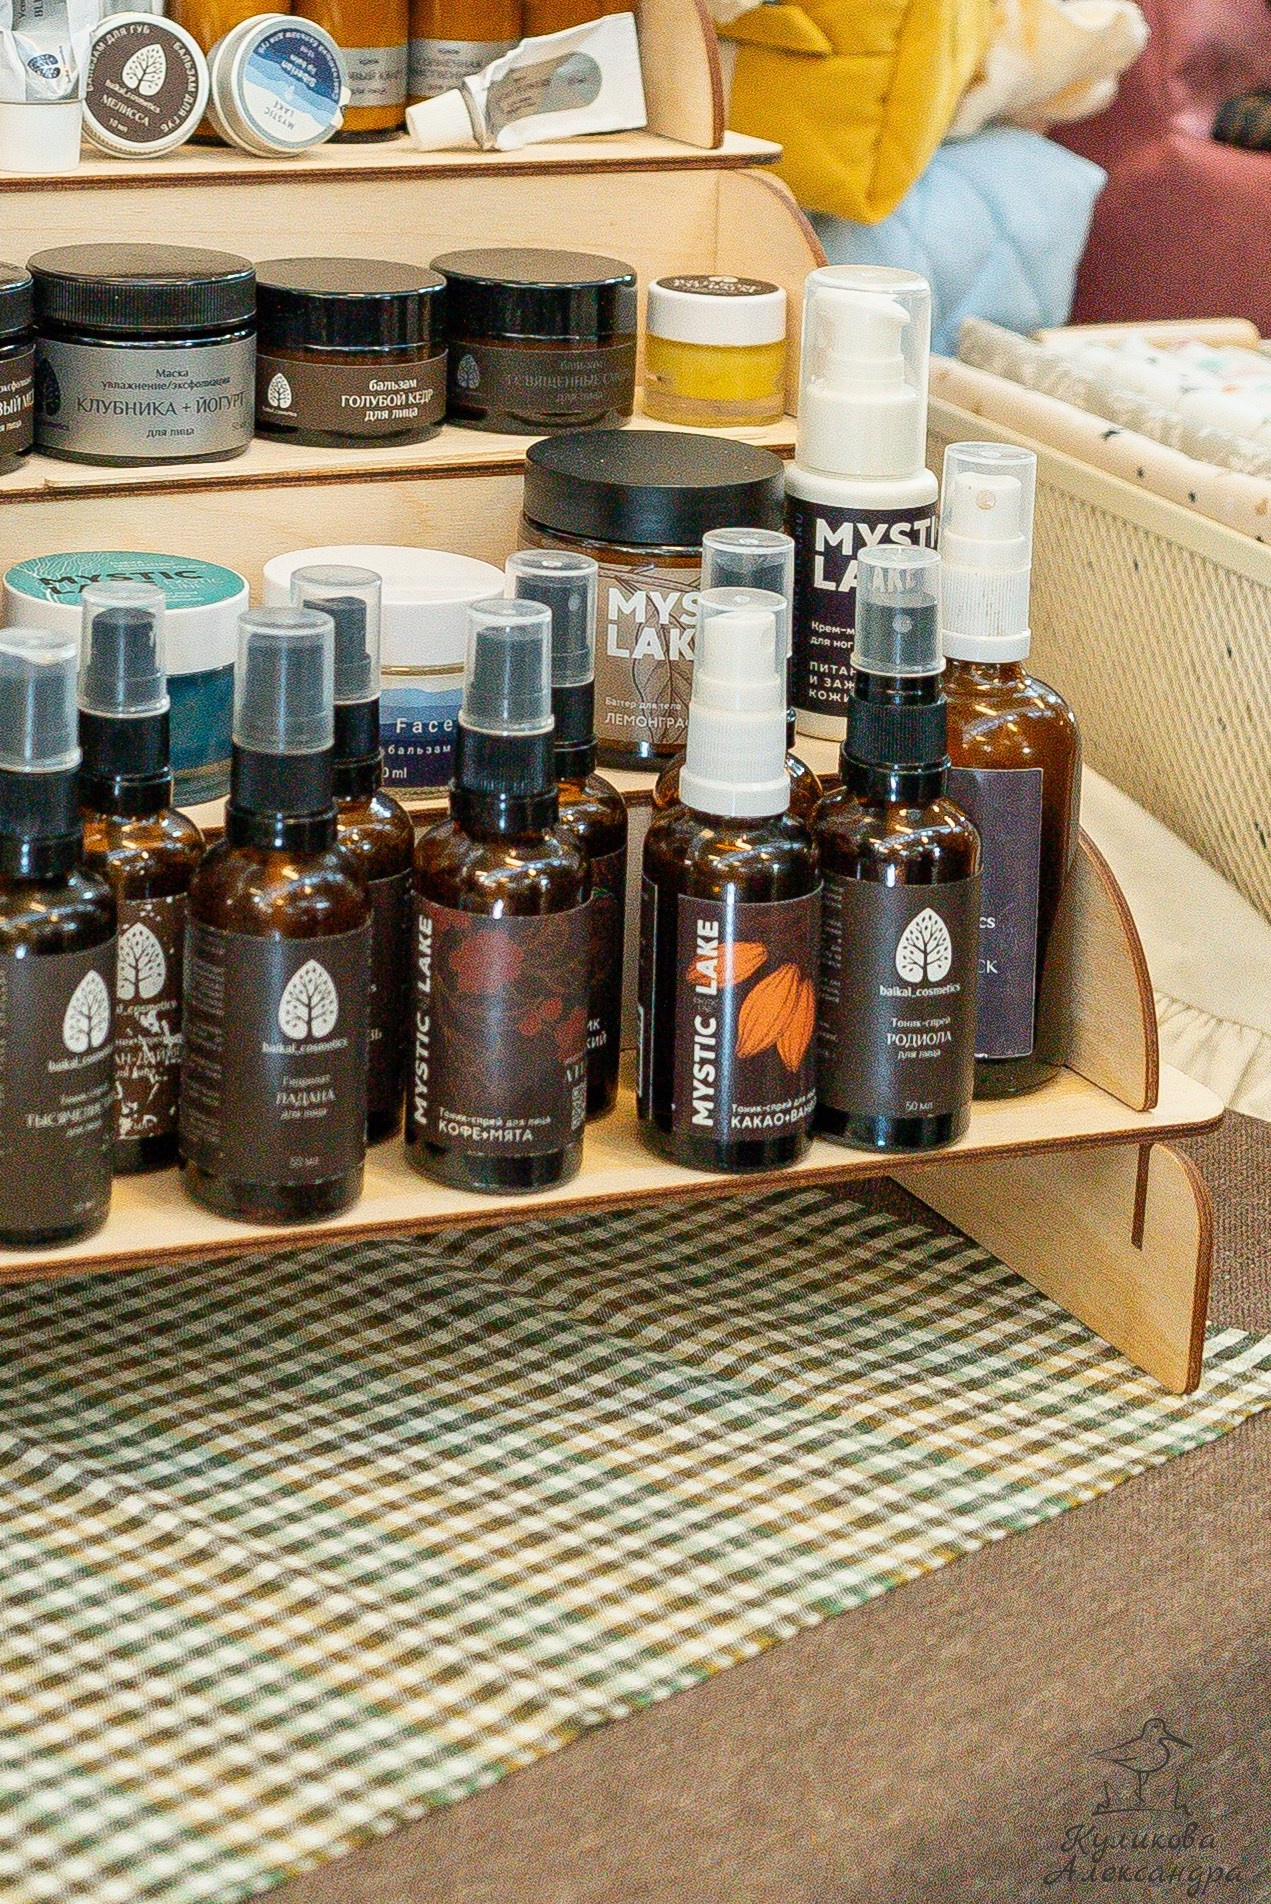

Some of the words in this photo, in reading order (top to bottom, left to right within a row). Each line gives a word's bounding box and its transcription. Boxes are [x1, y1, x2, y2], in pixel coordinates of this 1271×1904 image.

[105, 27, 127, 45] ДЛЯ
[129, 24, 151, 34] ГУБ
[172, 41, 197, 92] БАЛЬЗАМ
[101, 94, 150, 127] МЕЛИССА
[178, 94, 195, 116] ДЛЯ
[273, 99, 295, 117] LAKE
[160, 116, 180, 133] ГУБ
[263, 106, 295, 131] MYSTIC
[156, 368, 189, 379] Маска
[369, 378, 418, 391] бальзам
[76, 396, 178, 417] КЛУБНИКА
[195, 390, 247, 414] ЙОГУРТ
[341, 392, 406, 408] ГОЛУБОЙ
[408, 389, 434, 405] КЕДР
[364, 408, 389, 422] для
[391, 407, 418, 419] лица
[146, 428, 167, 439] для
[170, 427, 195, 437] лица
[815, 516, 937, 556] MYSTI
[38, 570, 204, 586] MYSTIC
[608, 587, 700, 625] MYS
[811, 620, 855, 635] Крем-м
[607, 623, 696, 661] LAK
[810, 636, 831, 648] для
[833, 639, 854, 650] ног
[809, 661, 856, 677] ПИТАН
[809, 675, 819, 686] И
[823, 676, 855, 690] ЗАЖ
[396, 717, 453, 733] Face
[388, 744, 451, 755] бальзам
[418, 914, 434, 994] LAKE
[696, 919, 720, 996] LAKE
[879, 983, 961, 998] baikal_cosmetics
[886, 1031, 952, 1048] РОДИОЛА
[414, 1012, 431, 1125] MYSTIC
[692, 1014, 718, 1126] MYSTIC
[439, 1120, 534, 1142] КОФЕ+МЯТА
